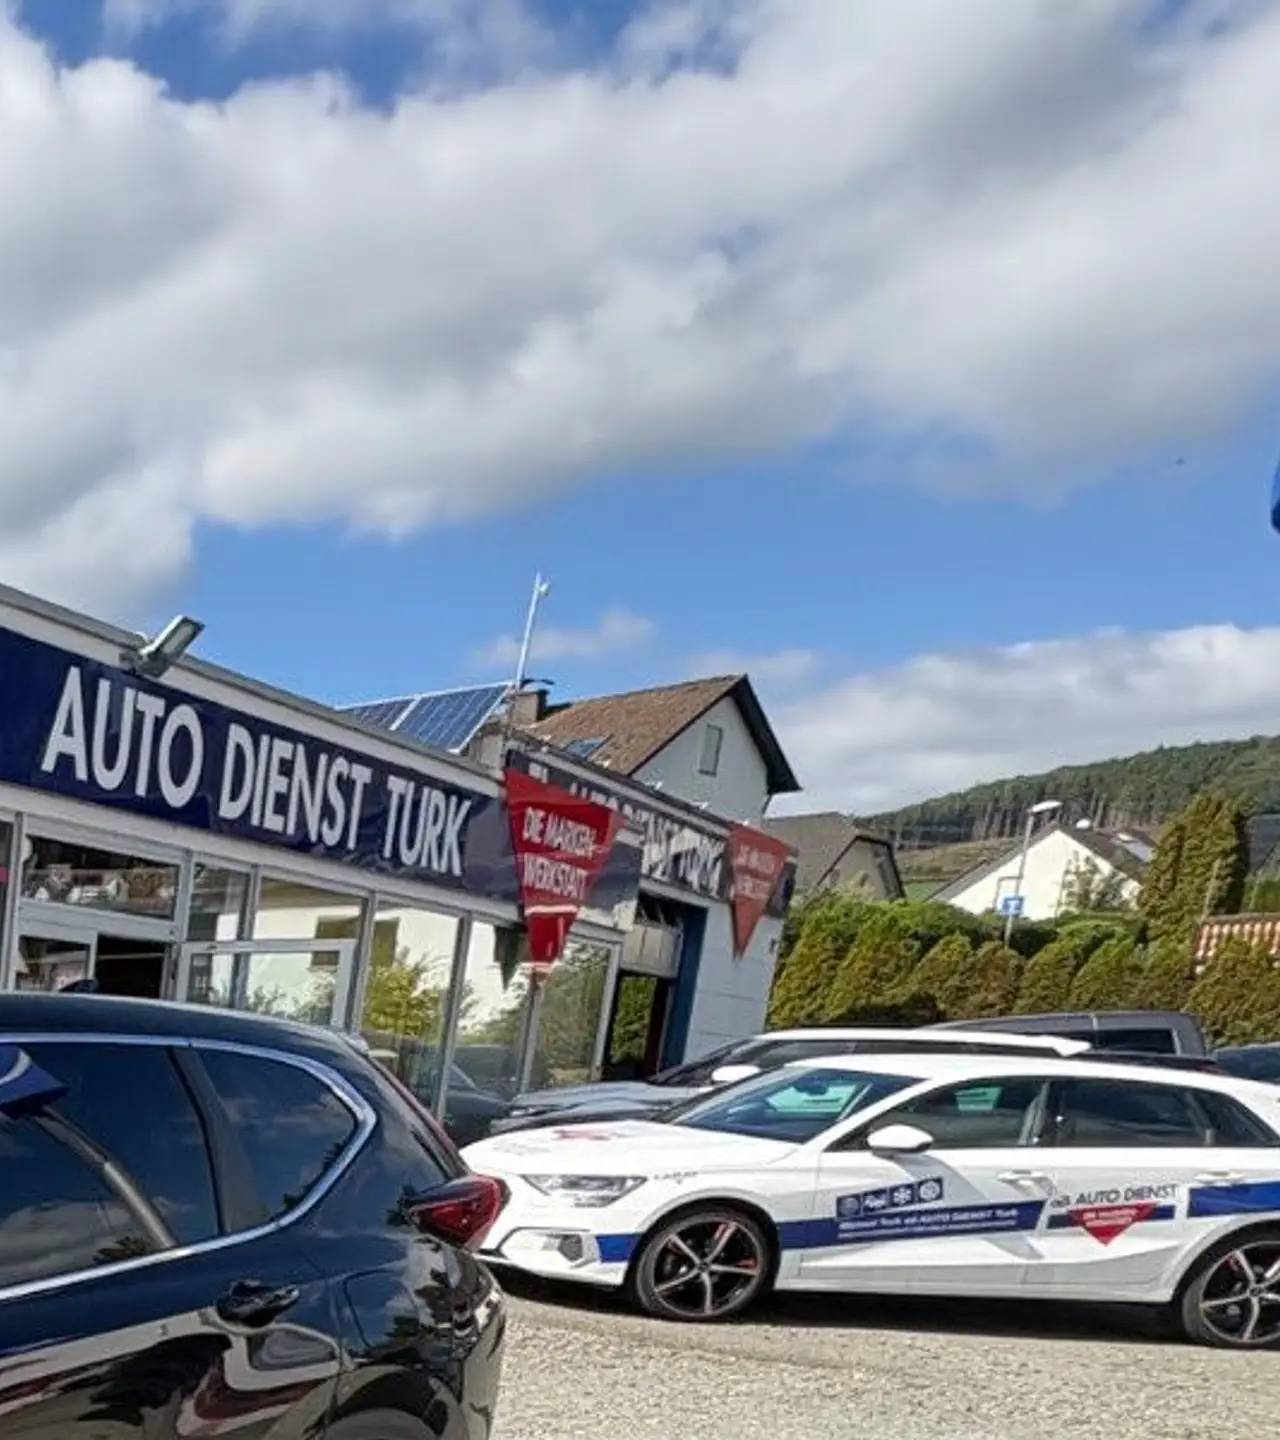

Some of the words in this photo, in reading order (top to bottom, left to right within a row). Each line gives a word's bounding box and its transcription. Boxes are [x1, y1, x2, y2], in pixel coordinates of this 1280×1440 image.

[40, 665, 203, 808] AUTO
[219, 724, 372, 852] DIENST
[384, 776, 472, 878] TURK
[523, 806, 546, 844] DIE
[523, 853, 589, 901] WERKSTATT
[1075, 1189, 1121, 1205] AUTO
[1123, 1184, 1178, 1201] DIENST
